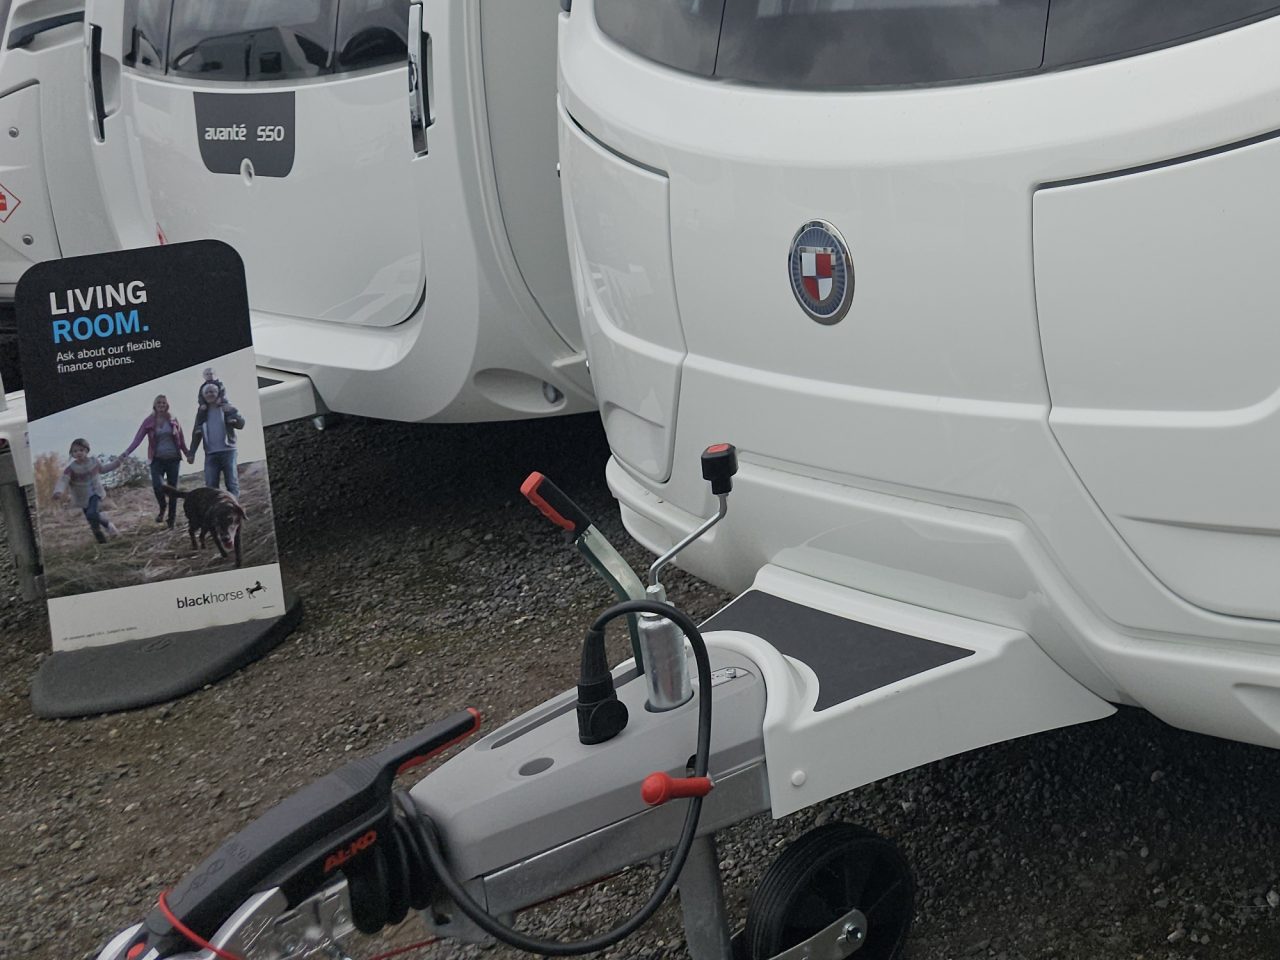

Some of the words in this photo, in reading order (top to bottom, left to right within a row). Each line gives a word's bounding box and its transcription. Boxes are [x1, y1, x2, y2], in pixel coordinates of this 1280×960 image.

[204, 123, 247, 141] avanté
[256, 125, 285, 142] 550
[49, 280, 148, 316] LIVING
[52, 309, 149, 344] ROOM.
[56, 350, 75, 362] Ask
[77, 346, 106, 359] about
[108, 345, 125, 355] our
[126, 338, 162, 353] flexible
[57, 361, 94, 374] finance
[95, 355, 135, 369] options.
[176, 589, 244, 610] blackhorse
[323, 830, 378, 874] AL-KO
